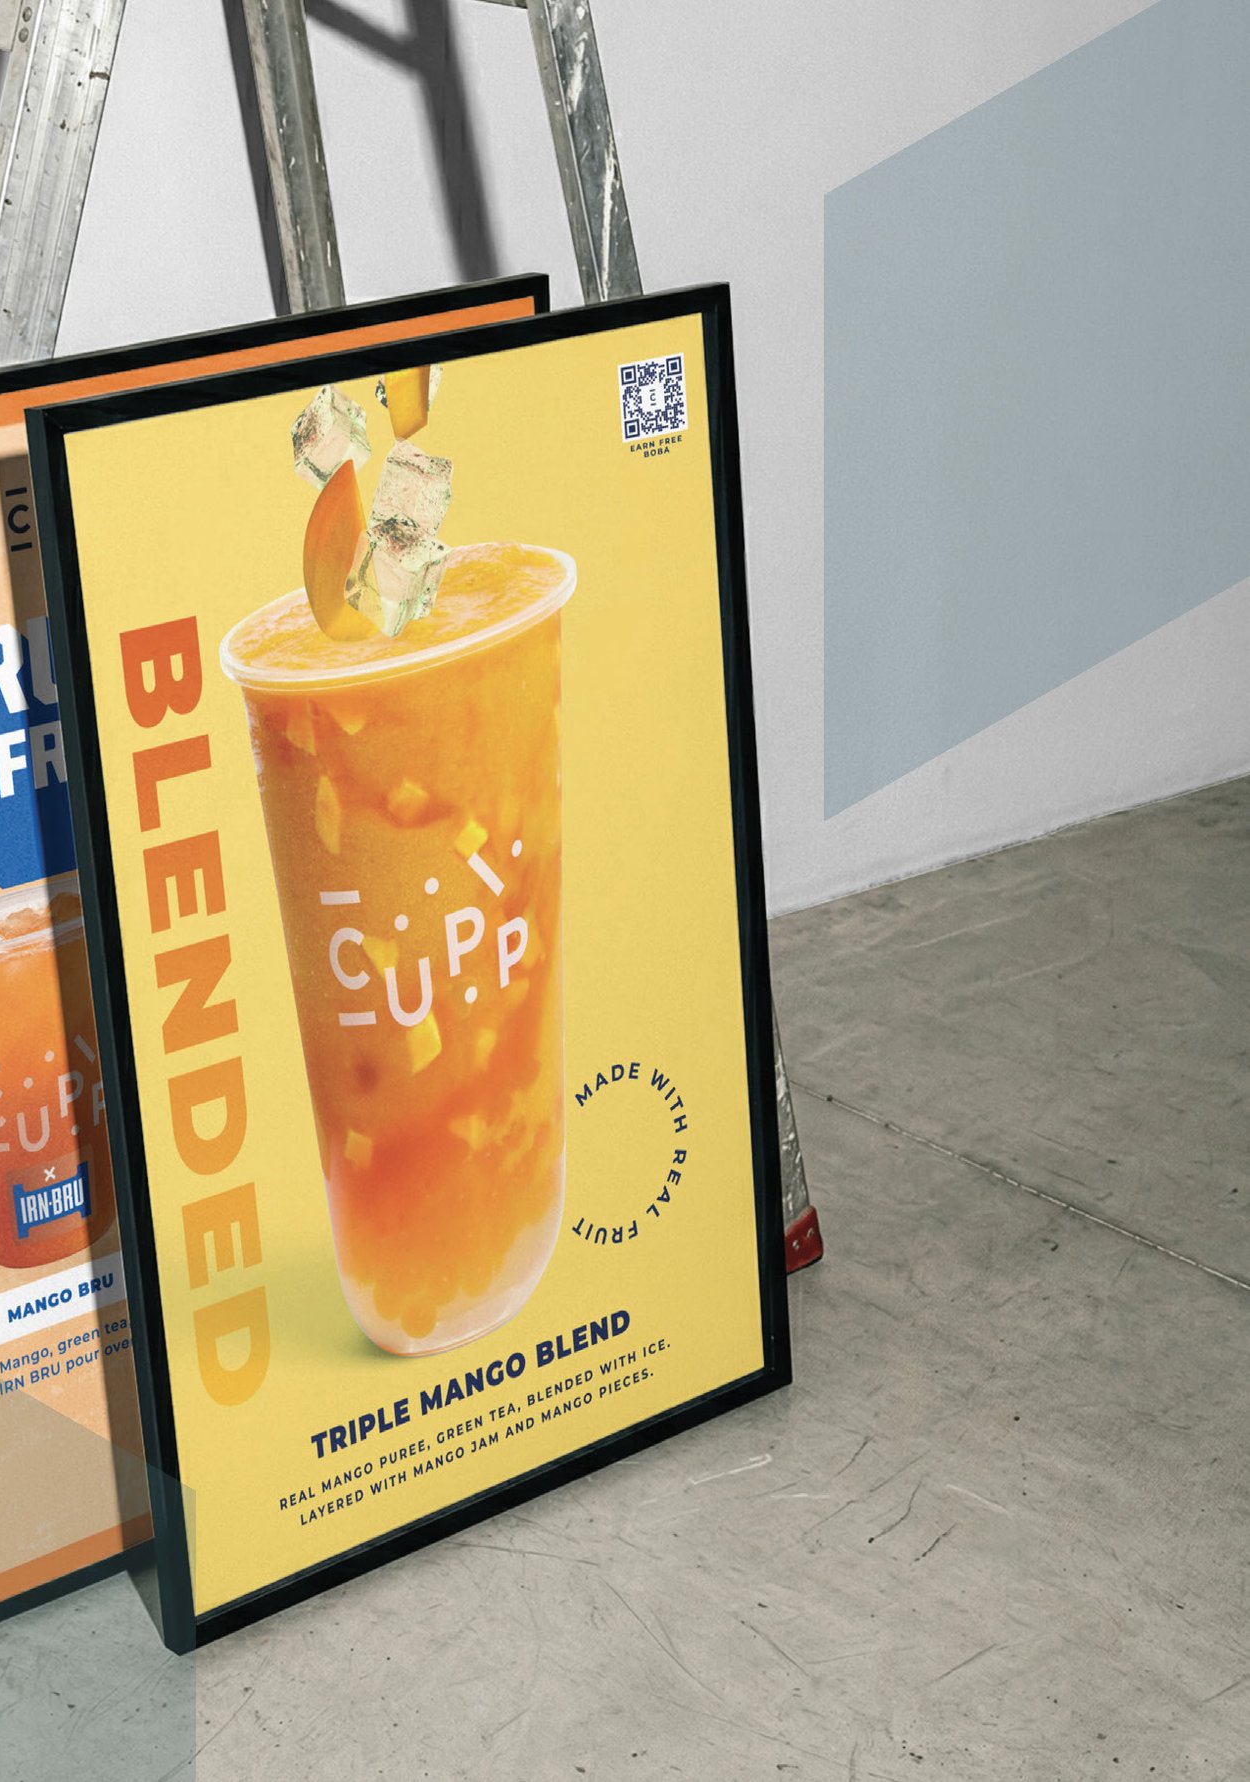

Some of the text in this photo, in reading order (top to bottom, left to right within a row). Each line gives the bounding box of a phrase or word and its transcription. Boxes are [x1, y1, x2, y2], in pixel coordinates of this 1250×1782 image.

[630, 434, 683, 452] EARN FREE
[643, 446, 670, 458] BOBA
[119, 615, 272, 1407] BLENDED
[571, 1061, 688, 1245] MADE WITH REAL FRUIT
[7, 1272, 114, 1323] MANGO BRU
[0, 1347, 53, 1374] Mango,
[57, 1328, 101, 1355] green
[0, 1338, 132, 1396] IRN BRU pour ove
[310, 1310, 631, 1459] TRIPLE MANGO BLEND
[279, 1338, 671, 1511] REAL MANGO PUREE, GREEN TEA, BLENDED WITH ICE.
[300, 1367, 654, 1526] LAYERED WITH MANGO JAM AND MANGO PIECES.
